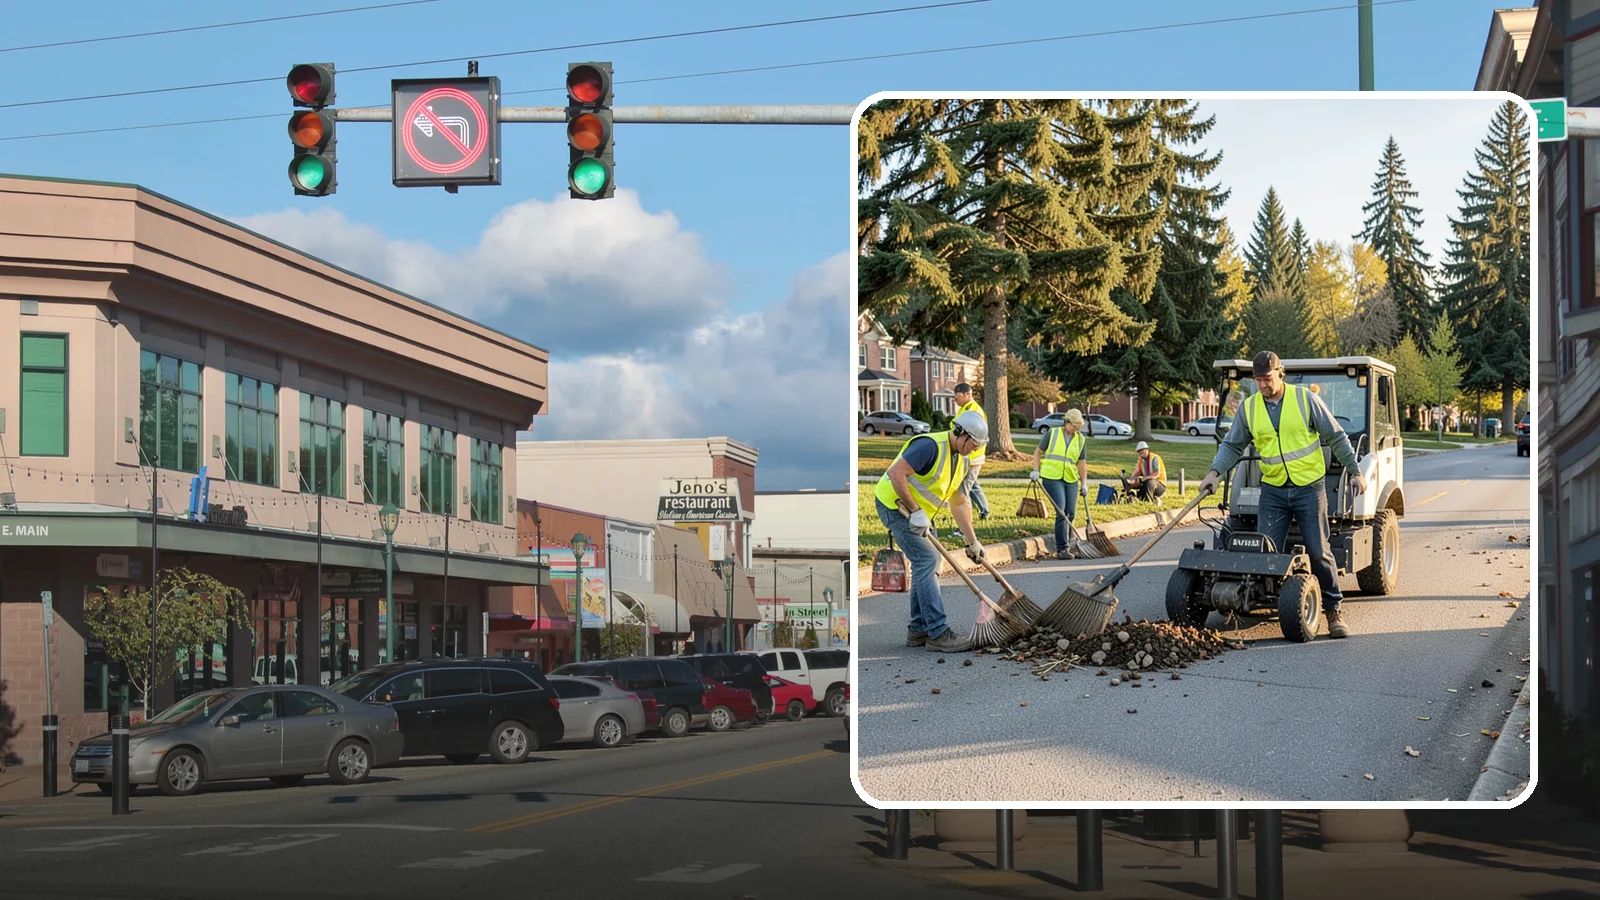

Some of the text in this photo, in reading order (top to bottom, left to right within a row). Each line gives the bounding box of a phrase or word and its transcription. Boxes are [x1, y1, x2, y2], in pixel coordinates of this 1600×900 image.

[669, 480, 728, 495] Jeno's
[665, 496, 731, 509] restaurant
[658, 509, 682, 519] Italian
[686, 509, 715, 519] American
[715, 509, 737, 519] Cuisine
[2, 525, 49, 536] E. MAIN
[785, 607, 795, 617] in
[797, 607, 828, 617] Street
[790, 619, 824, 628] lass
